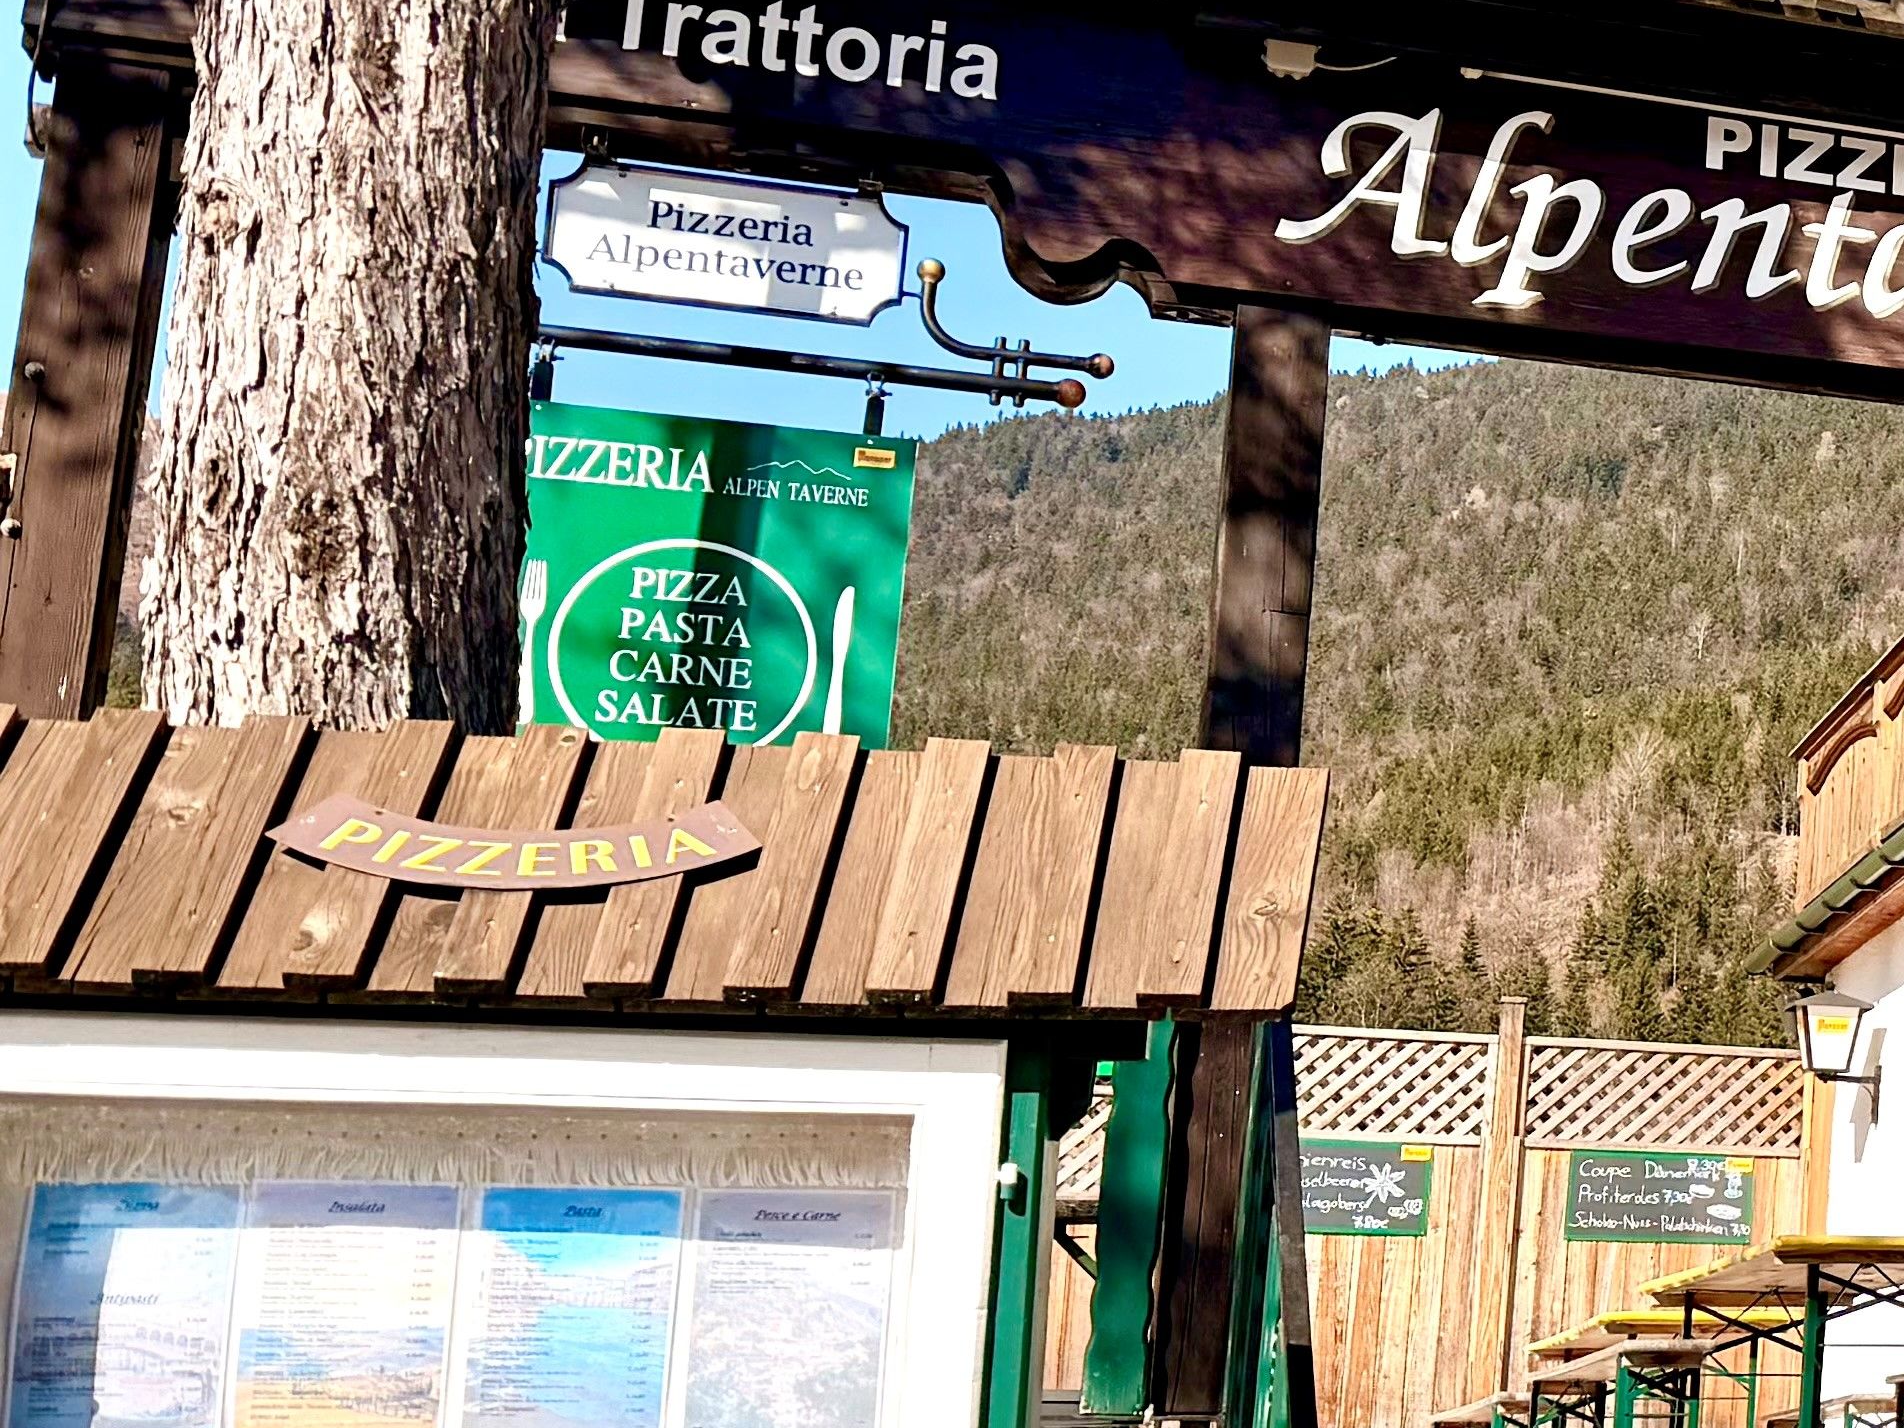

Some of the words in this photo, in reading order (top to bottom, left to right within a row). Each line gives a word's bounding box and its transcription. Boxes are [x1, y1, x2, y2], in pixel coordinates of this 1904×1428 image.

[646, 199, 814, 248] Pizzeria
[586, 232, 865, 292] Alpentaverne
[723, 476, 781, 501] ALPEN
[788, 482, 869, 508] TAVERNE
[628, 565, 748, 607] PIZZA
[617, 607, 752, 649] PASTA
[609, 649, 753, 690] CARNE
[594, 689, 757, 732] SALATE
[318, 818, 717, 877] PIZZERIA
[1578, 1158, 1633, 1184] Coupe
